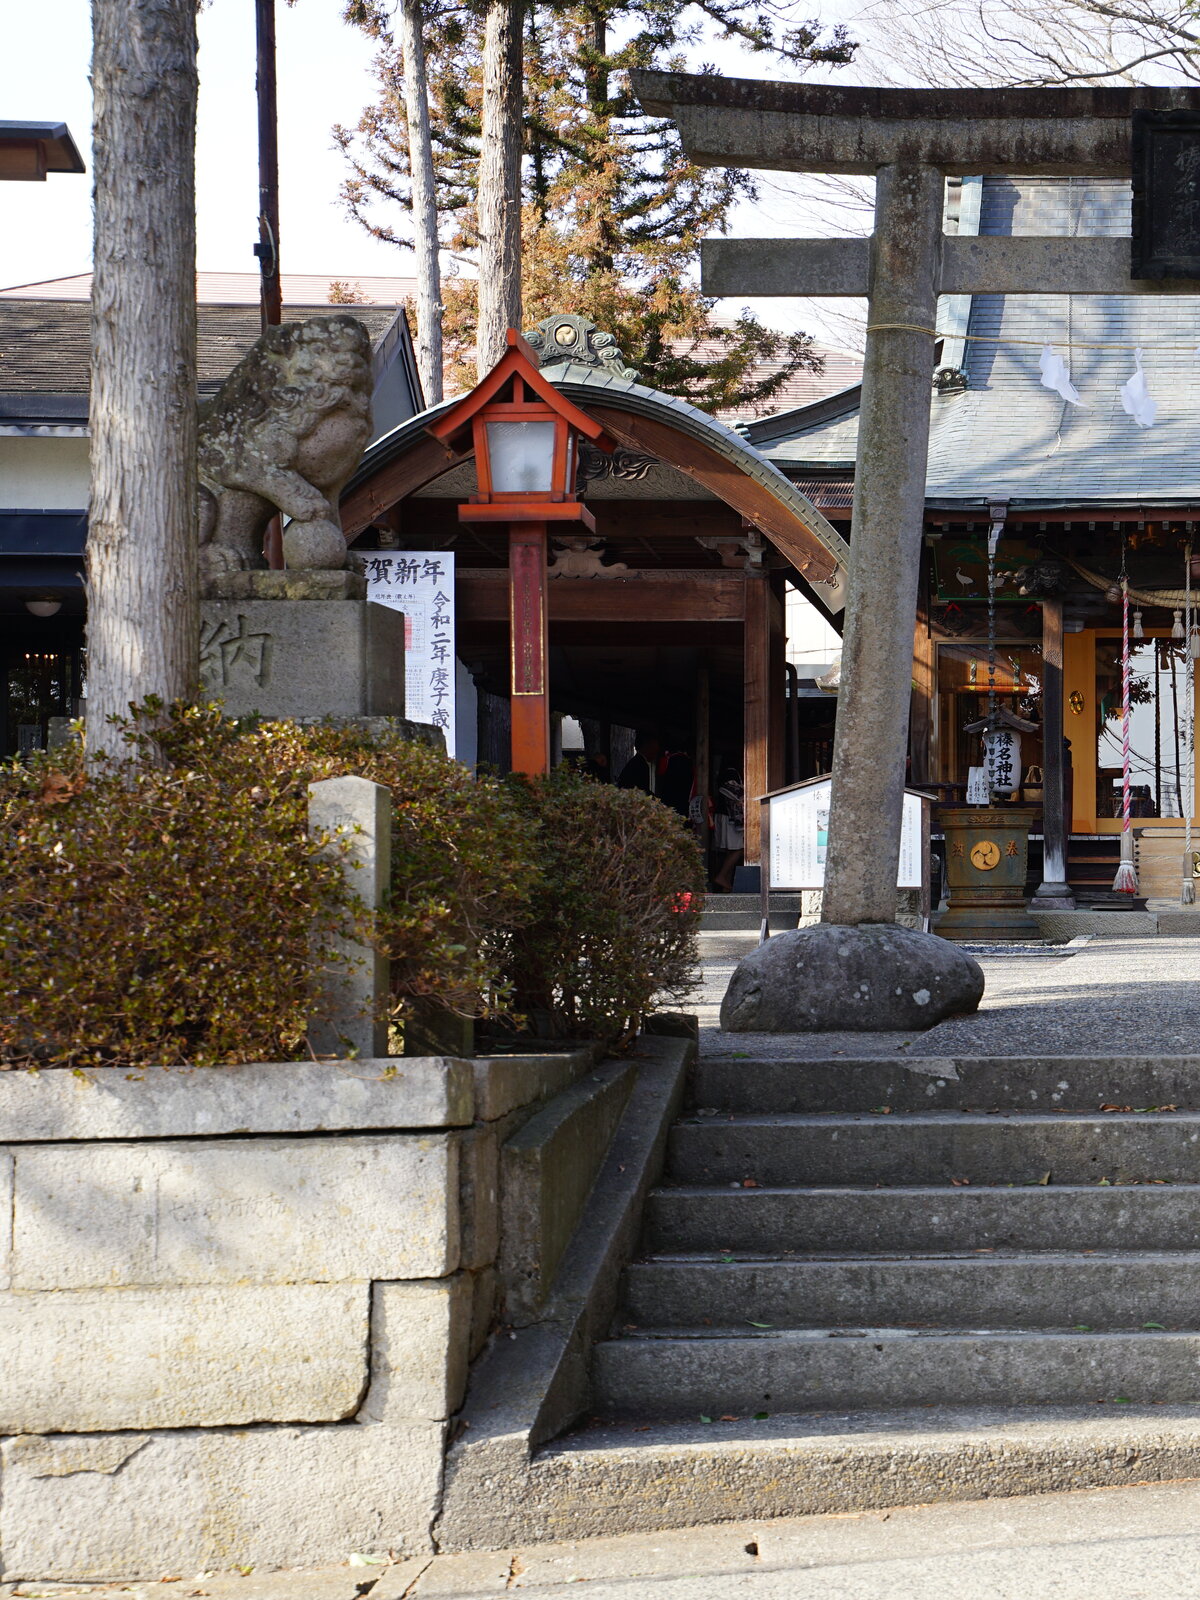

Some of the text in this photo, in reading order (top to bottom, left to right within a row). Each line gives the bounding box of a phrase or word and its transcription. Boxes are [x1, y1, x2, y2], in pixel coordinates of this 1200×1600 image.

[200, 614, 273, 688] 納
[429, 590, 451, 729] 令和二年庚子歳
[995, 732, 1014, 788] 榛名神社
